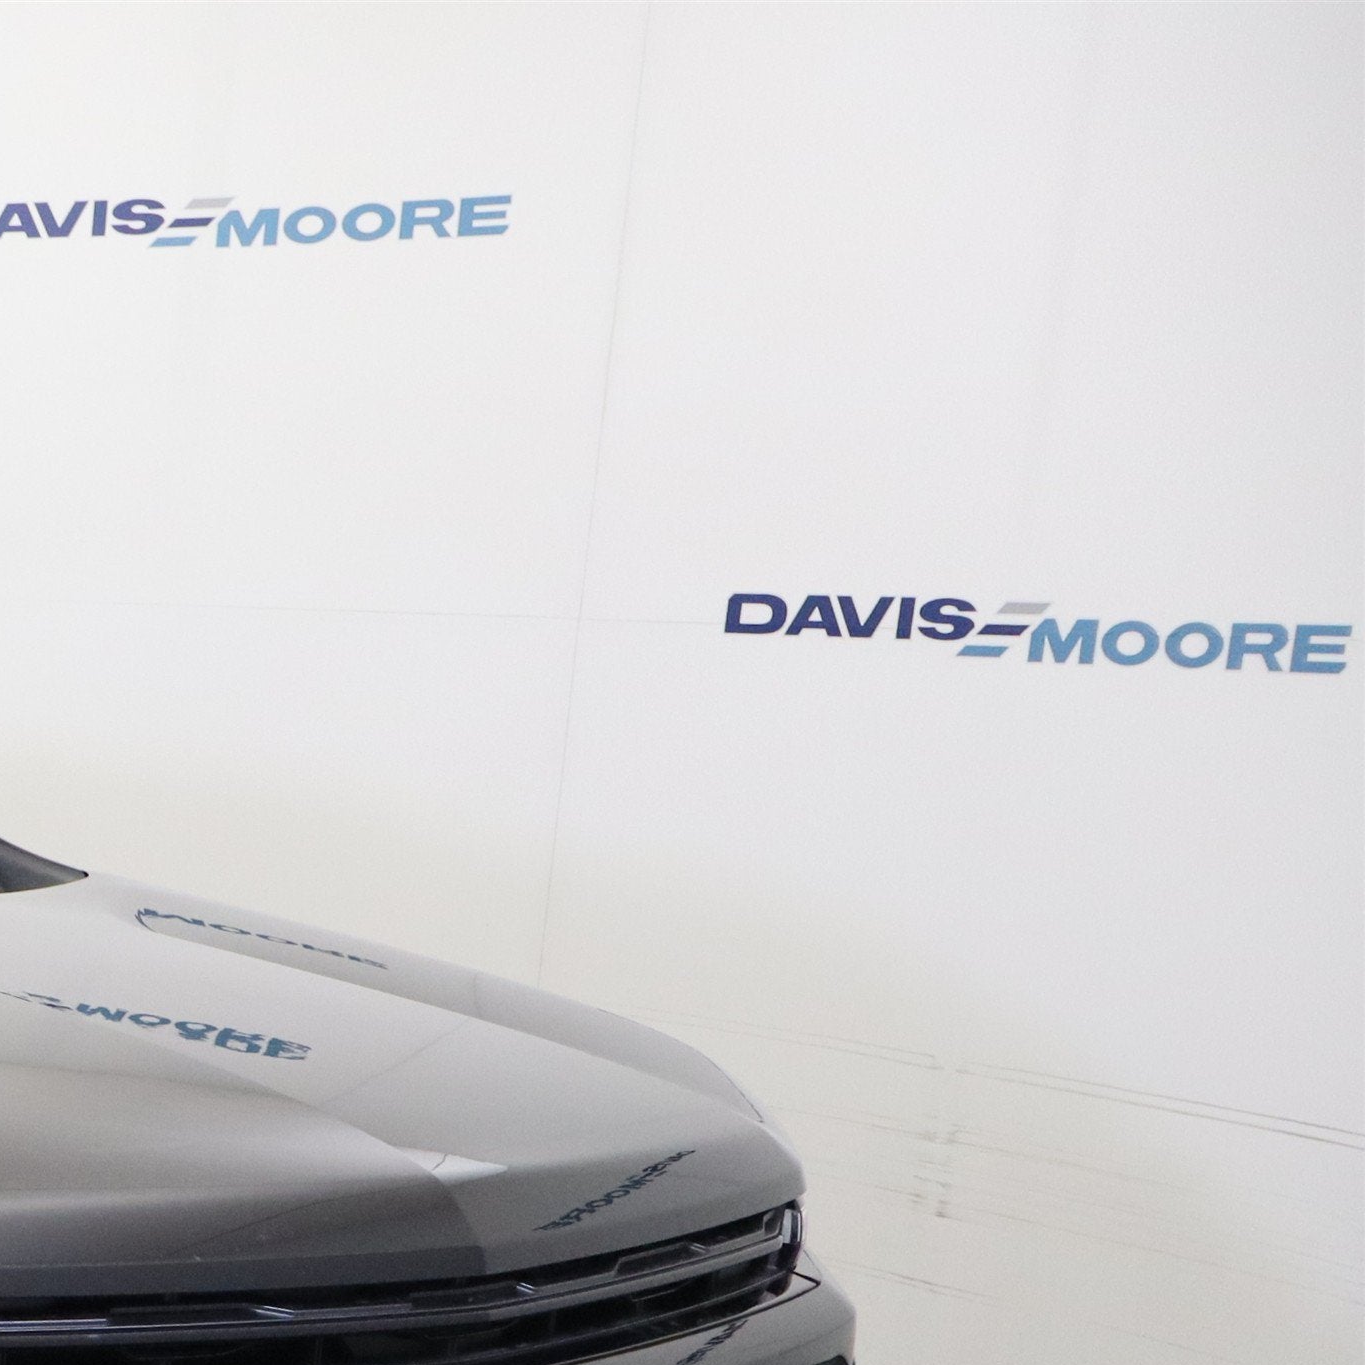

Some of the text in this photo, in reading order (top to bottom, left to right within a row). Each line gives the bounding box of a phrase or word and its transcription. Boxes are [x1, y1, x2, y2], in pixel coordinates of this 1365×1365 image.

[215, 195, 512, 248] MOORE
[724, 593, 1353, 674] DAVIS MOORE
